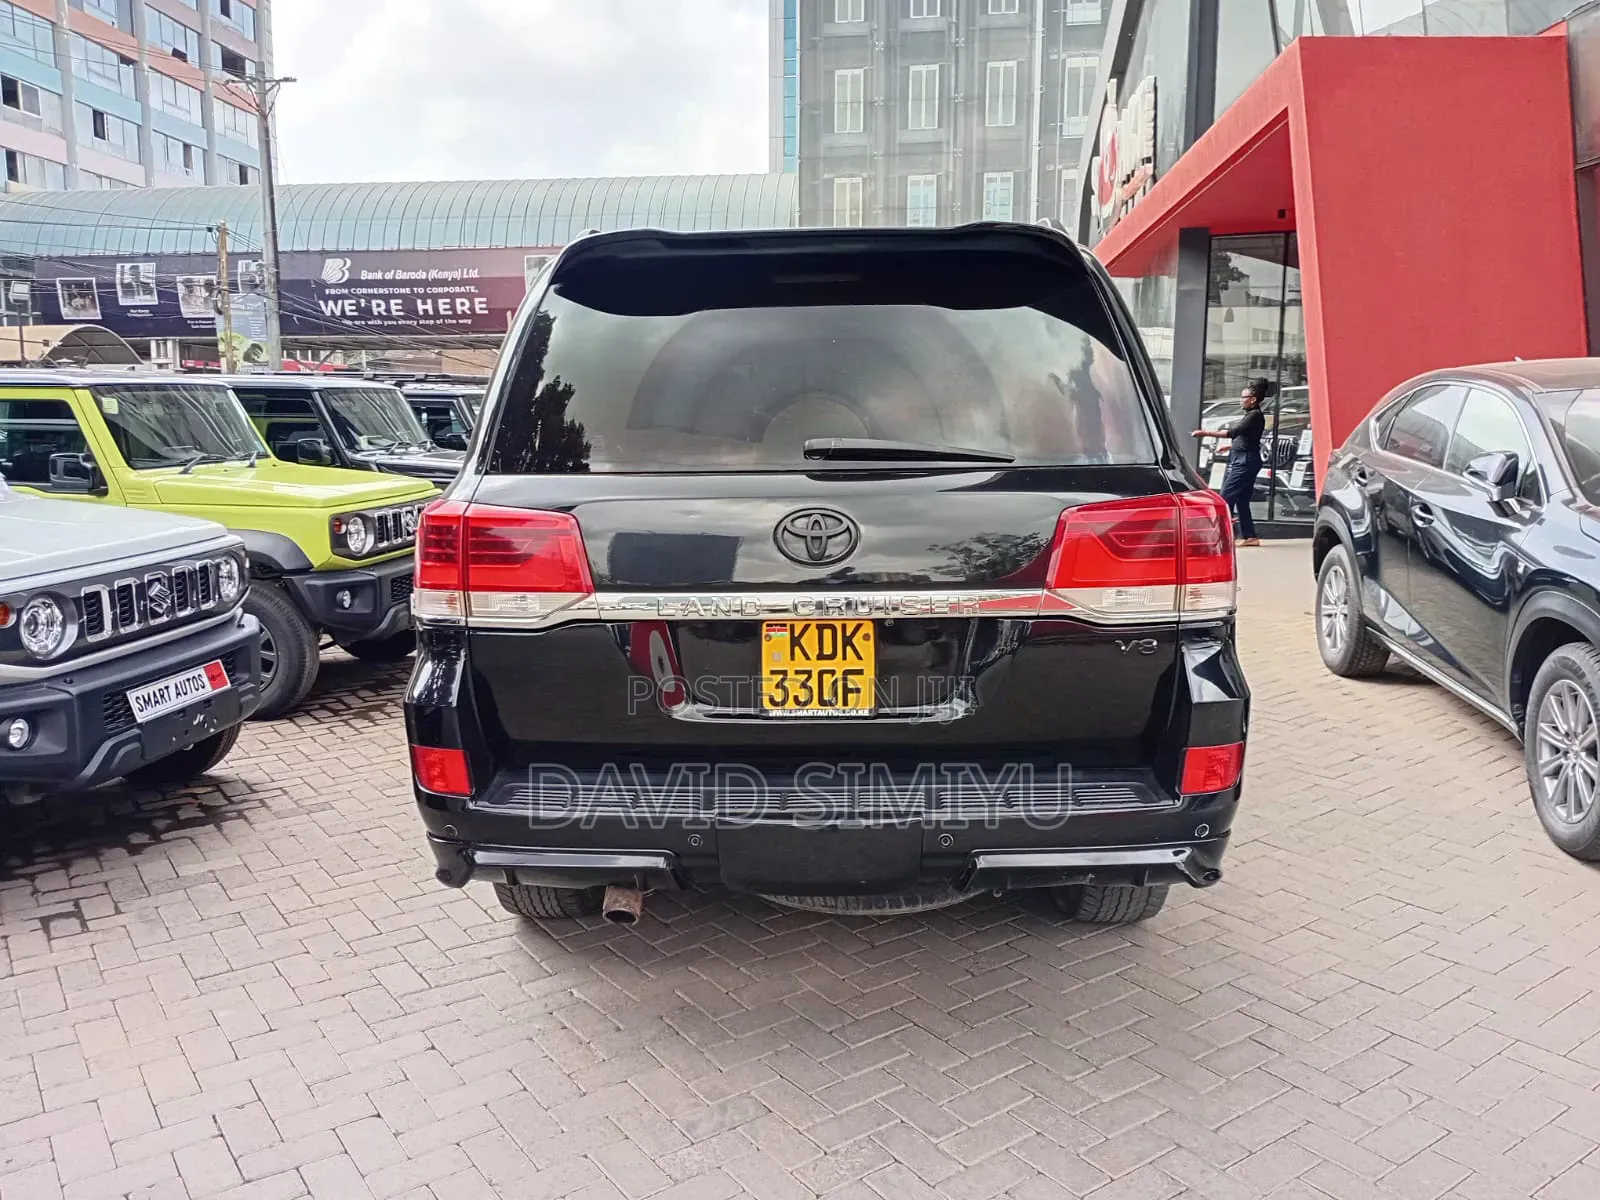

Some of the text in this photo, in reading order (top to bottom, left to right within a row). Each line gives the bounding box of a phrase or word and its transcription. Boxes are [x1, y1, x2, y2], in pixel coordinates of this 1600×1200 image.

[361, 268, 480, 282] Bank of Baroda (Kenya) Ltd.
[325, 285, 479, 296] FROM CORNERSTONE TO CORPORATE,
[318, 297, 489, 317] WE'RE HERE
[383, 319, 397, 327] you
[397, 319, 417, 327] every
[458, 318, 472, 326] way
[657, 594, 980, 617] LAND CRUISER
[789, 623, 864, 661] KDK
[1114, 638, 1158, 656] V8
[135, 685, 172, 713] SMART
[174, 673, 206, 699] AUTOS
[768, 668, 865, 707] 330F
